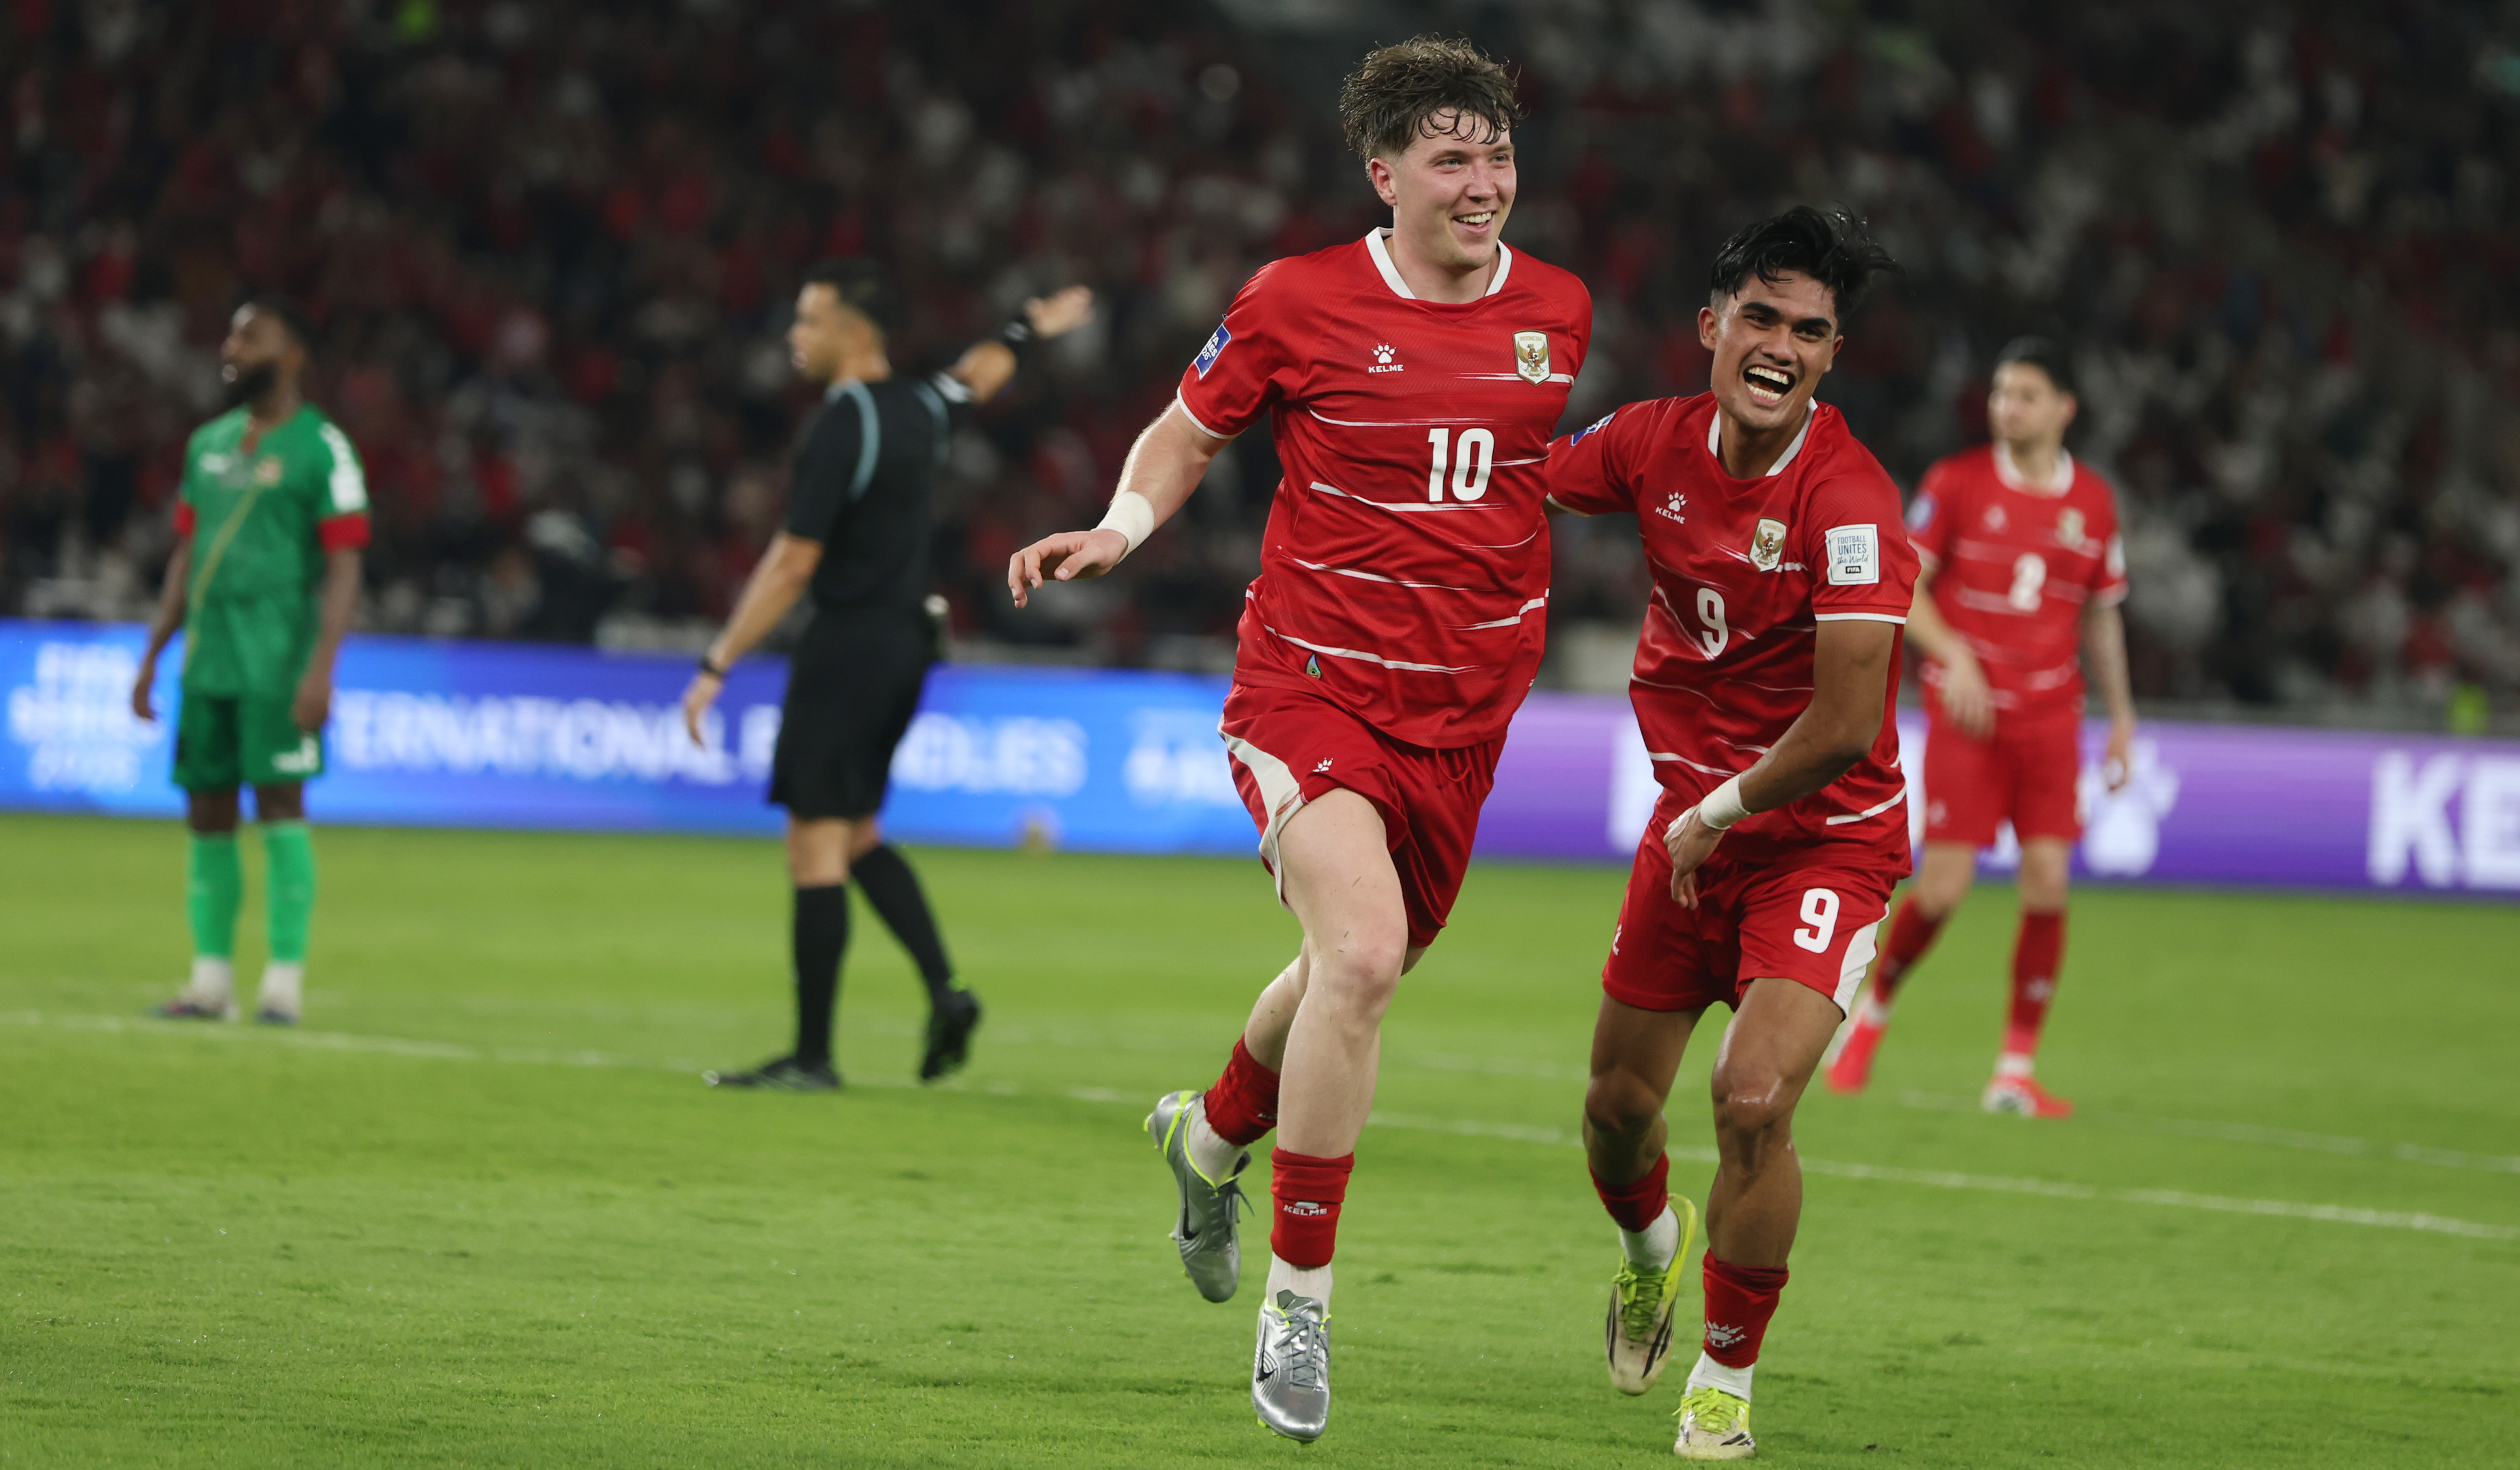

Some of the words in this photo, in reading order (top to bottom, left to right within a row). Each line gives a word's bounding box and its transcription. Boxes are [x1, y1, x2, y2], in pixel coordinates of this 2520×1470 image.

[1368, 364, 1404, 373] KELME
[1428, 427, 1495, 502] 10
[1655, 506, 1686, 524] KELME
[1837, 535, 1867, 544] FOOTBALL
[1839, 543, 1867, 555] UNITES
[1837, 556, 1847, 565] the
[1849, 554, 1869, 565] World
[2008, 552, 2047, 612] 2
[1697, 587, 1729, 657] 9
[1793, 888, 1841, 954] 9
[1284, 1204, 1327, 1216] KELME
